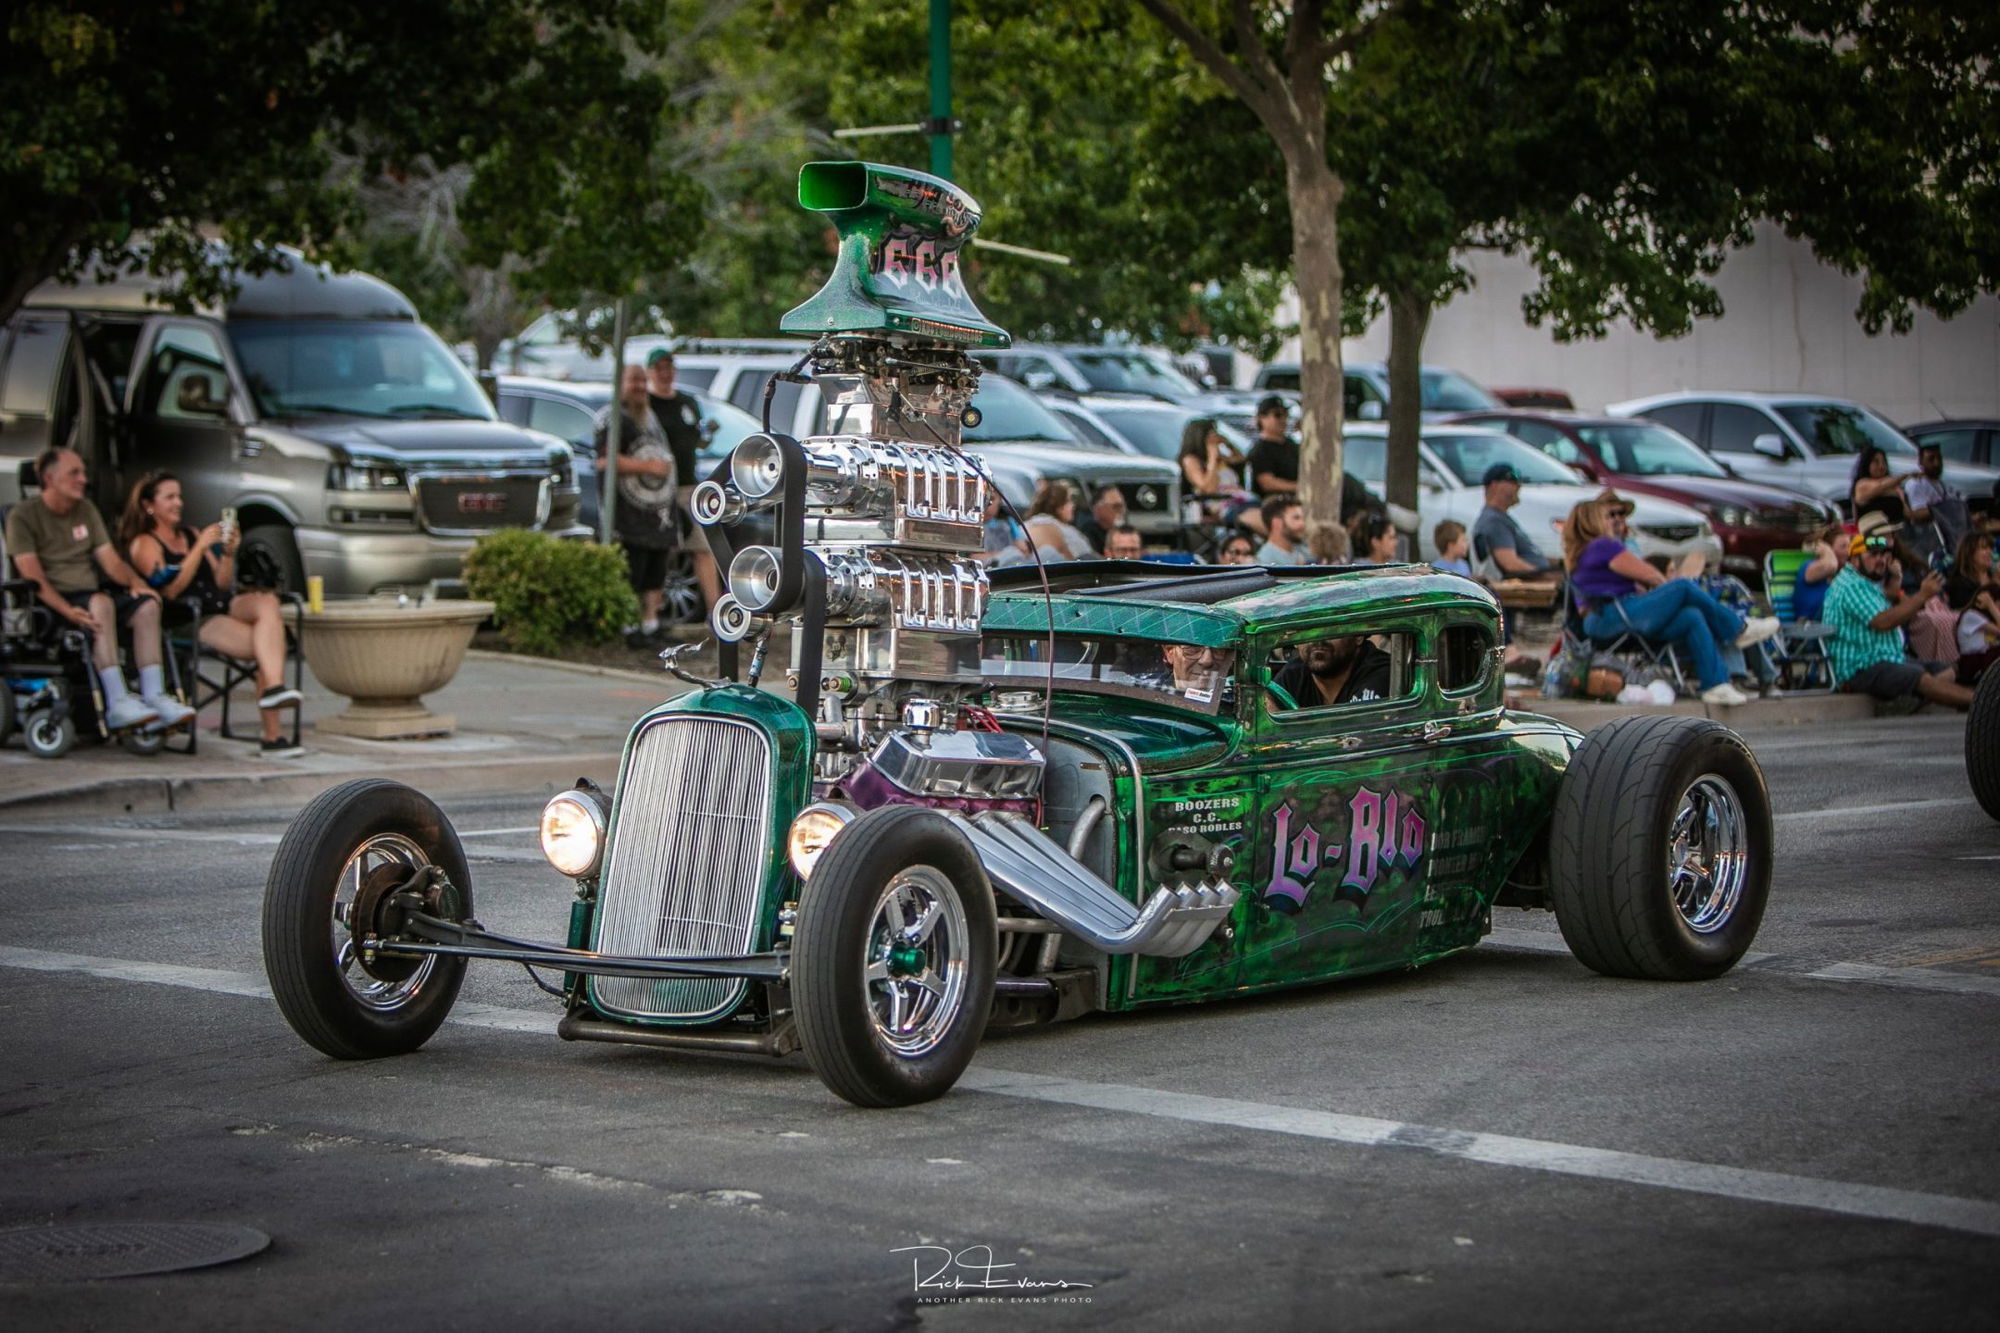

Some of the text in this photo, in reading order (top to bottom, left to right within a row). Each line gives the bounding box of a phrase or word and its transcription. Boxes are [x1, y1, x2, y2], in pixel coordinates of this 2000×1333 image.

[1175, 797, 1239, 812] BOOZERS
[1193, 812, 1221, 823] C.C.
[1200, 821, 1242, 833] ROBLES
